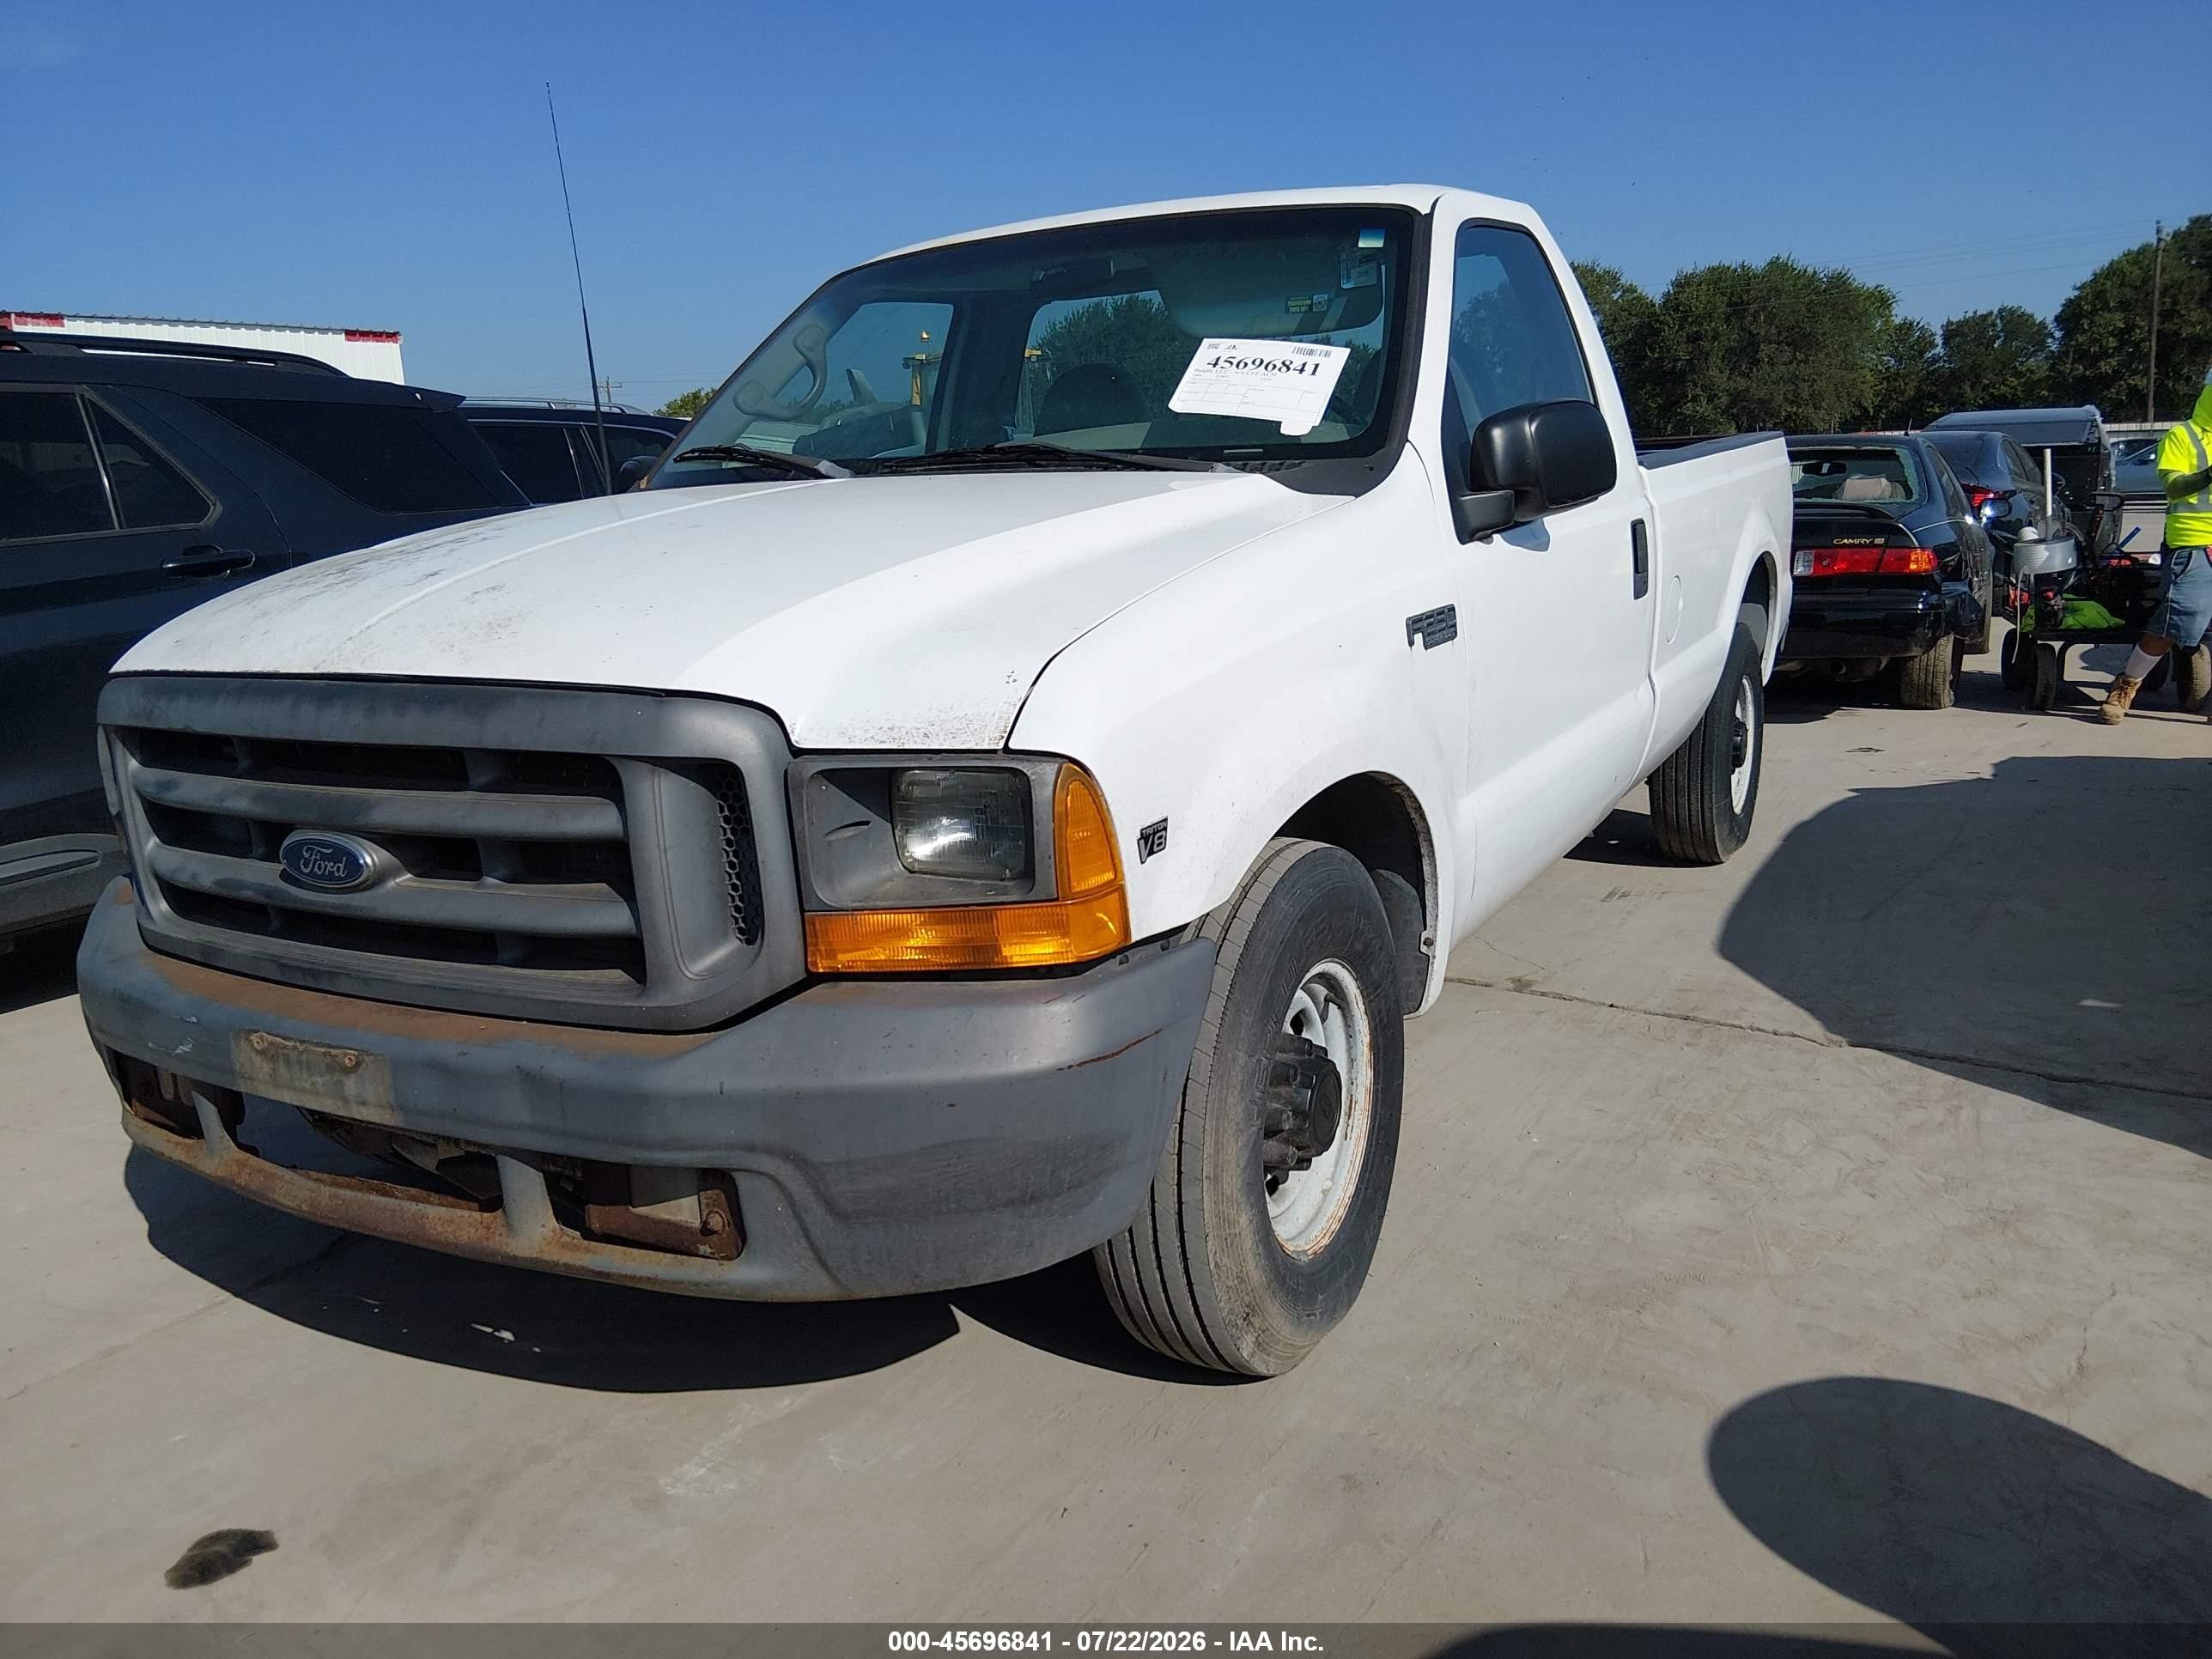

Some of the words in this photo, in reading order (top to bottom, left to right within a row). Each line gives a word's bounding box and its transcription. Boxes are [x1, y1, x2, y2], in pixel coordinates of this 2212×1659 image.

[1206, 355, 1322, 377] 45696841
[1141, 819, 1168, 837] TRITON
[1138, 830, 1167, 863] V8
[301, 844, 349, 878] Ford
